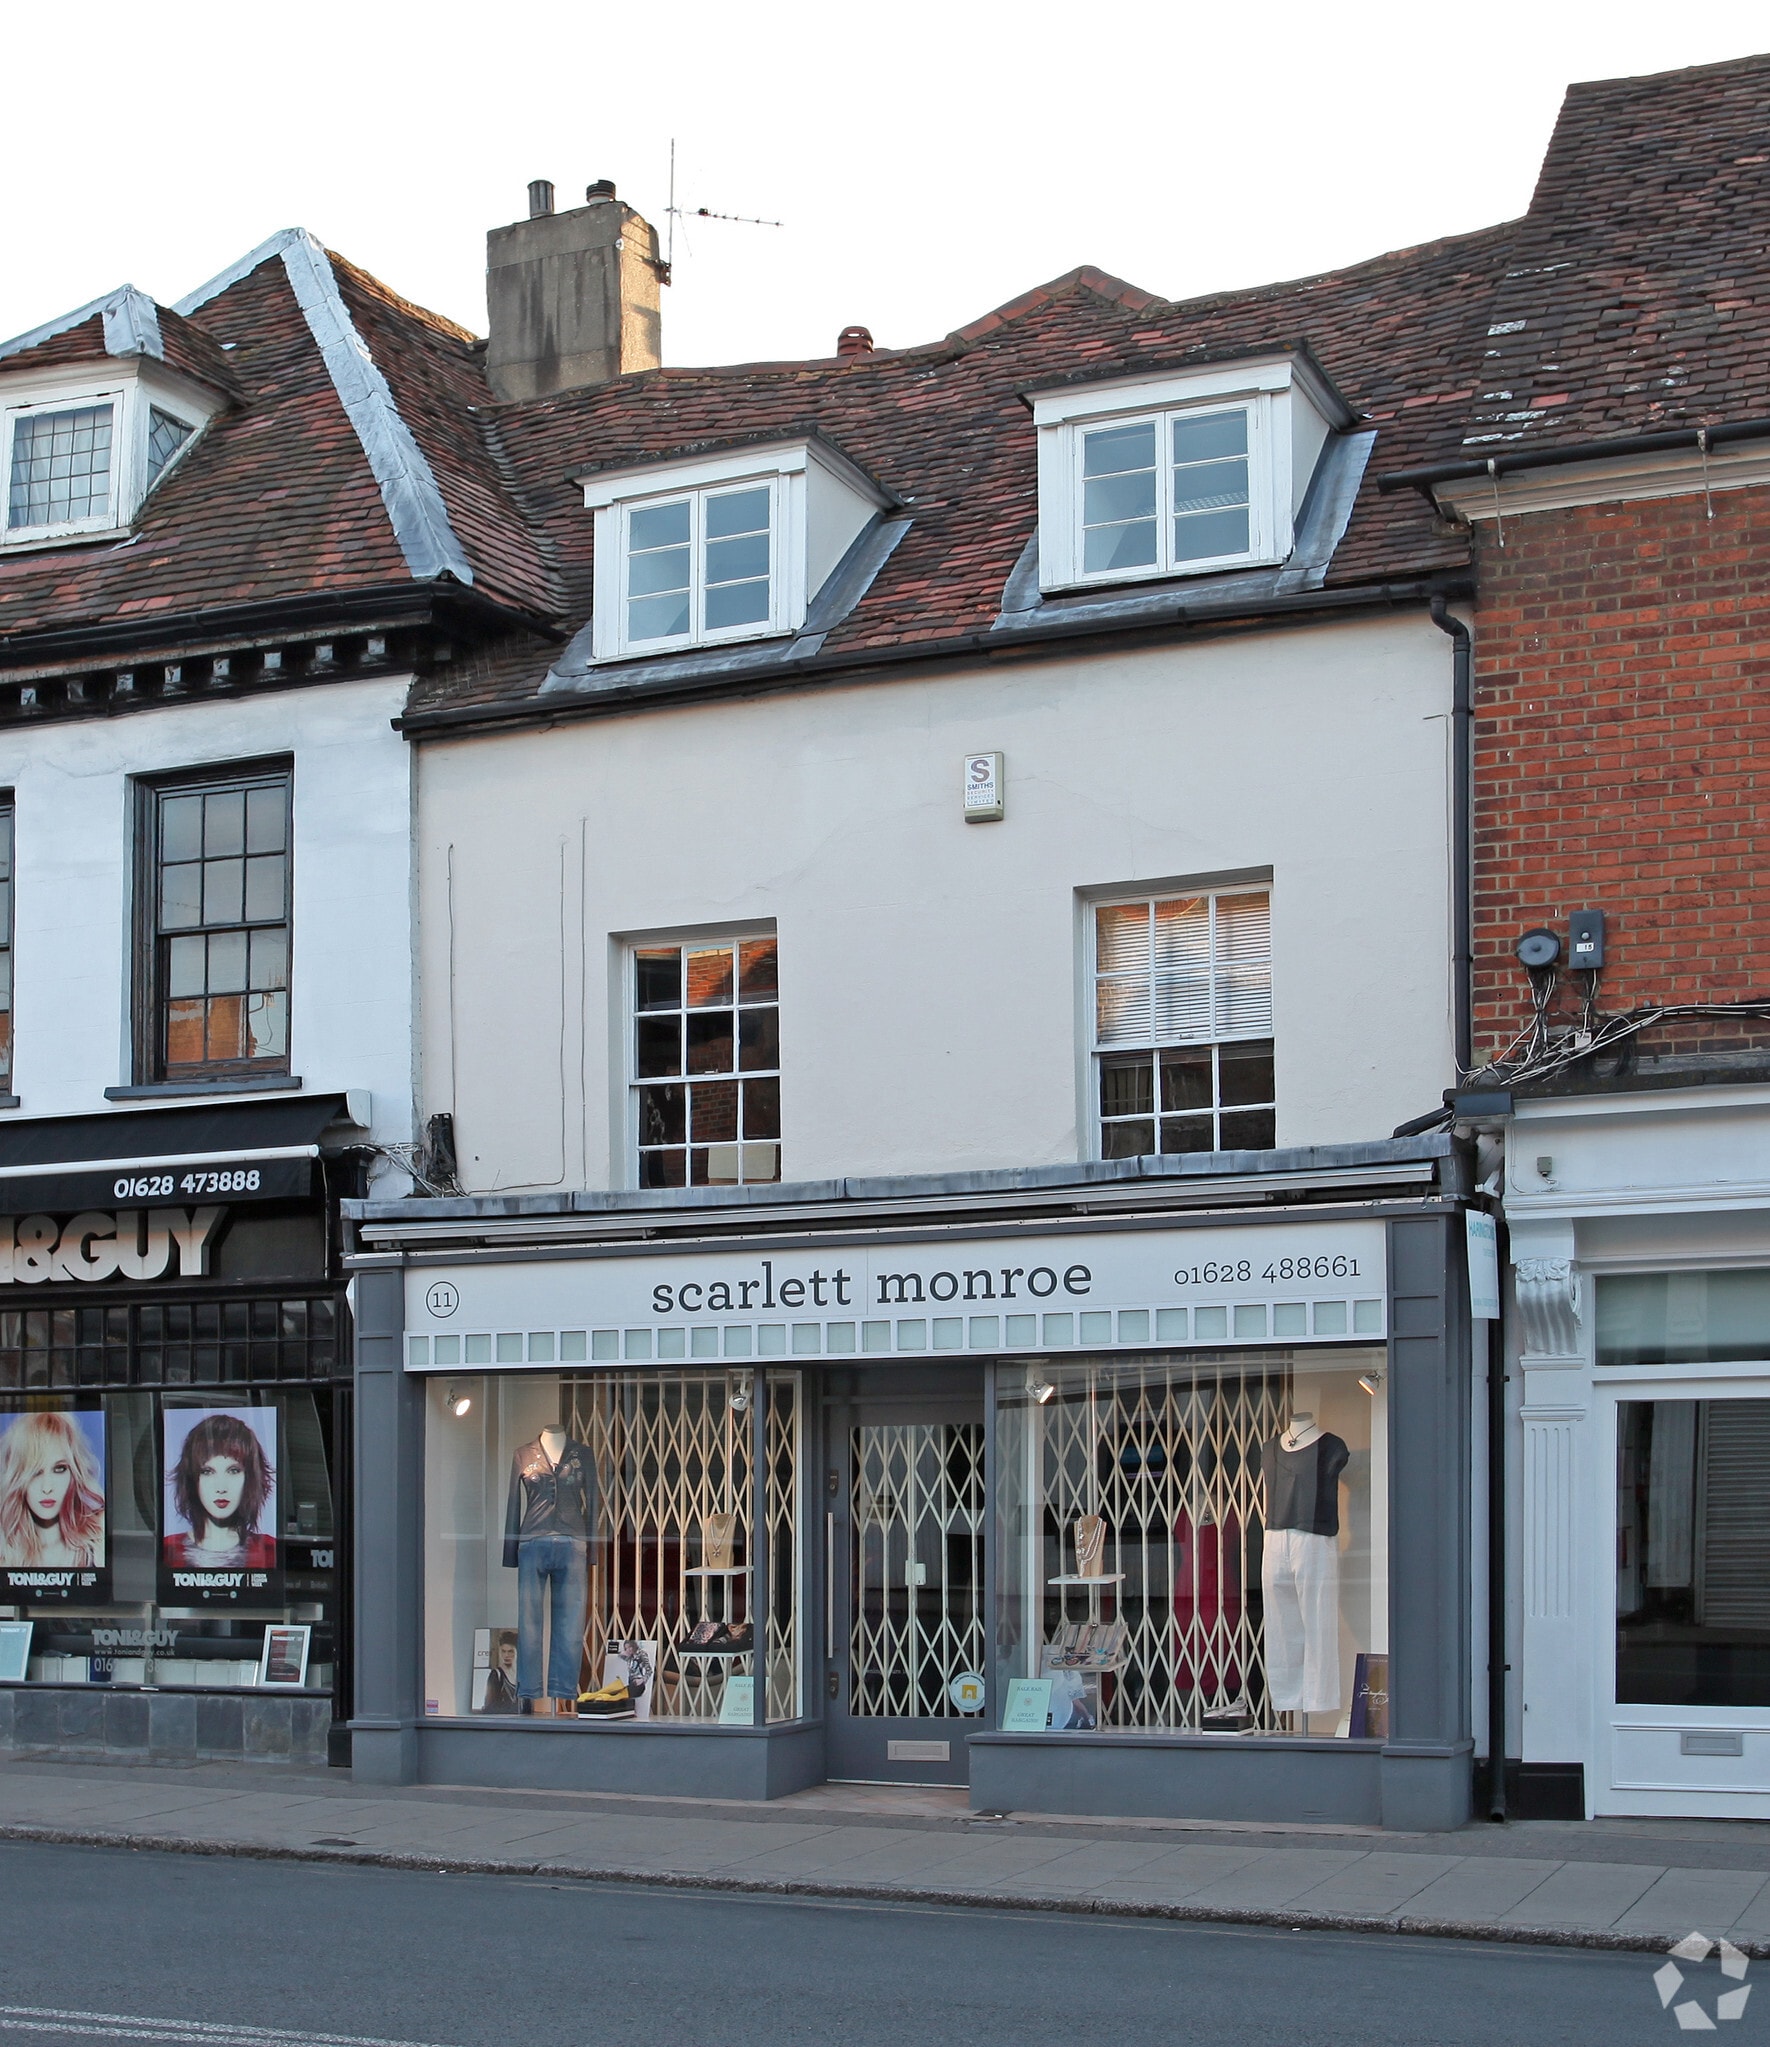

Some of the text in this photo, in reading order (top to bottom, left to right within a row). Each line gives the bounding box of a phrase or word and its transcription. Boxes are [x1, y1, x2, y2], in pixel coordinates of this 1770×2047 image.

[970, 759, 990, 782] S
[967, 782, 994, 791] SMITHS
[113, 1169, 261, 1199] 01628 473888
[1174, 1255, 1361, 1285] 01628 488661
[652, 1261, 1093, 1314] scarlett monroe
[433, 1292, 452, 1308] 11
[7, 1572, 75, 1587] TONI&GUY
[172, 1572, 245, 1587] TONI&GUY
[91, 1629, 180, 1647] TONI&GUY
